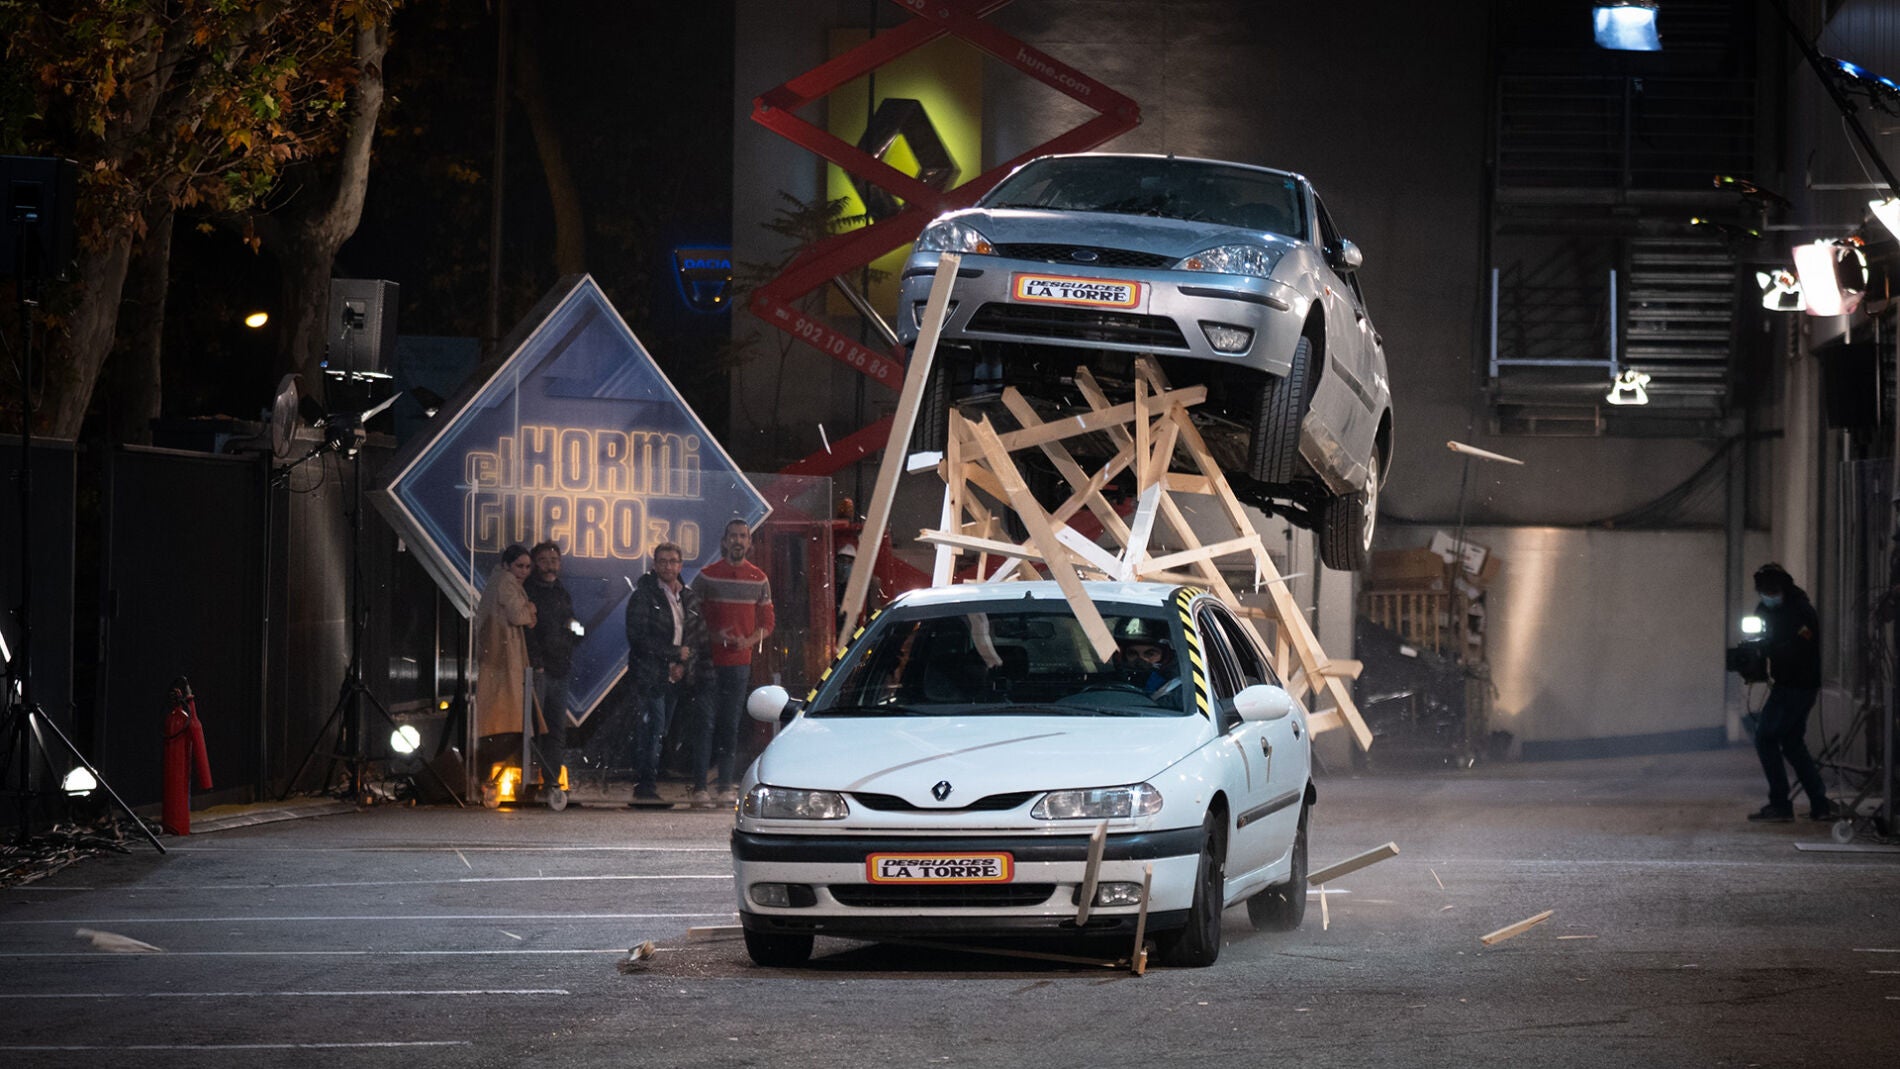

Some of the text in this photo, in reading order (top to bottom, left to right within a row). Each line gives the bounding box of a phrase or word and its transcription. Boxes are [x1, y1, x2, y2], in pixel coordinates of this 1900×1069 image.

[1016, 48, 1092, 96] hune.com
[1026, 286, 1126, 302] LA TORRE
[1029, 280, 1125, 292] DESGUACES
[795, 318, 888, 379] 902 10 86 86
[648, 518, 700, 561] 30
[881, 866, 999, 878] LA TORRE
